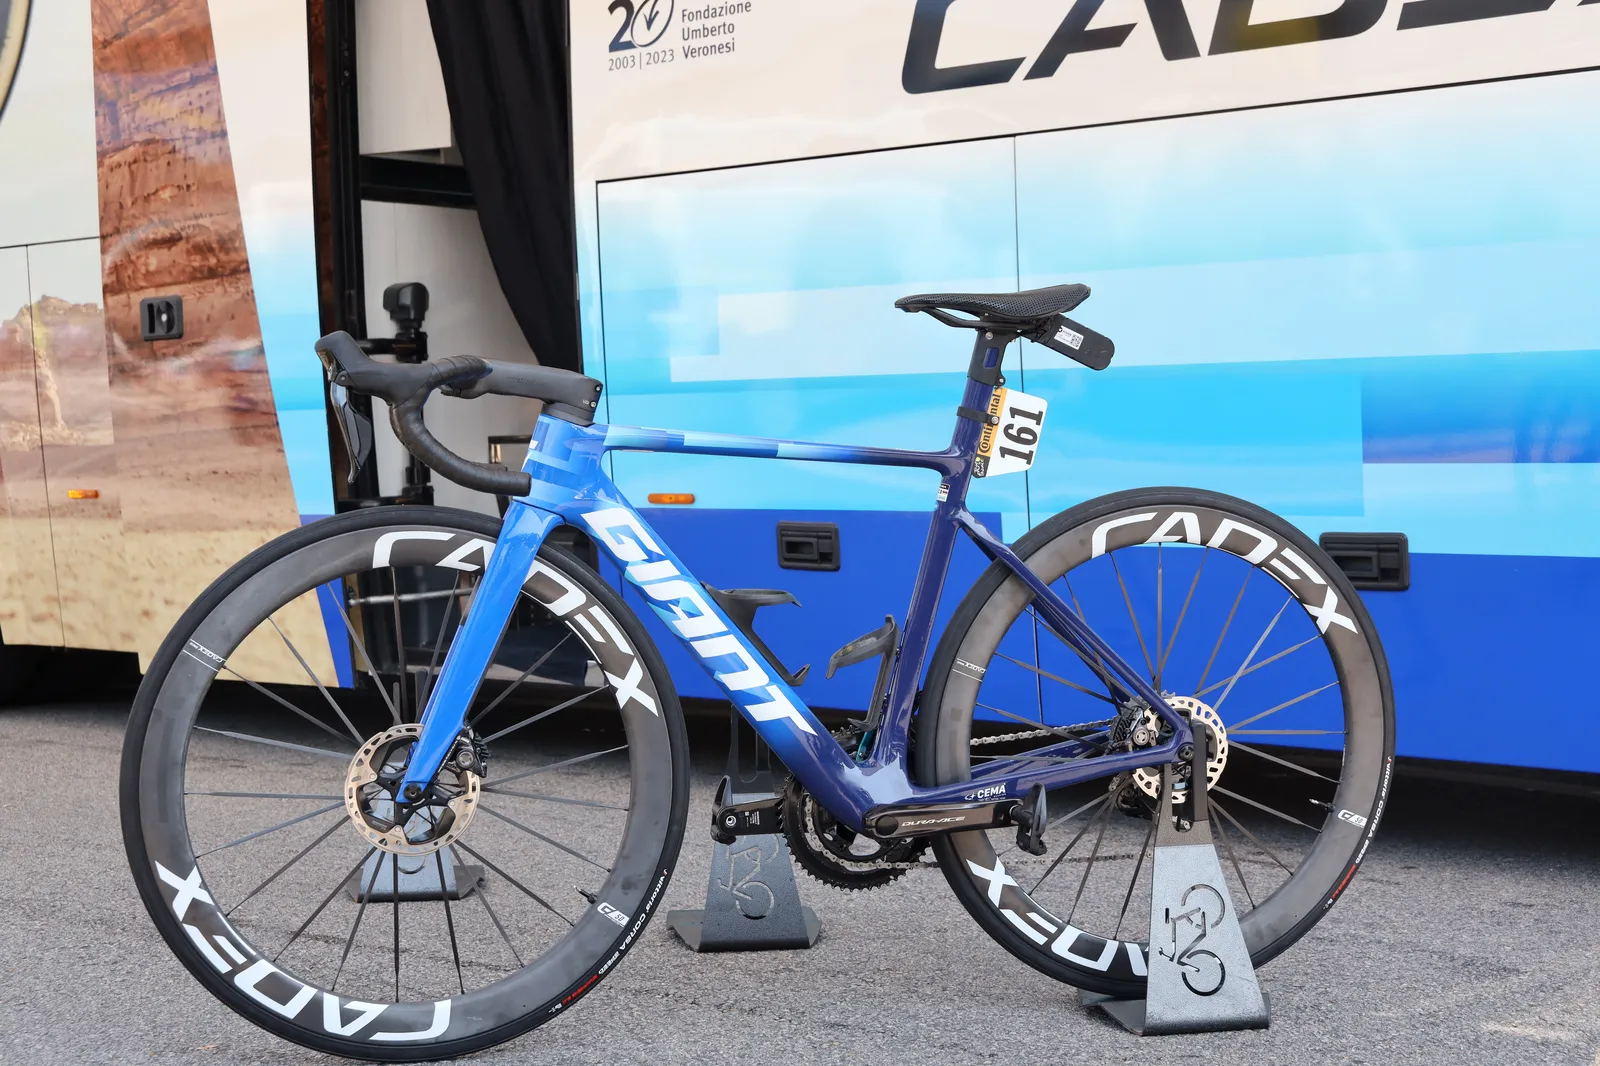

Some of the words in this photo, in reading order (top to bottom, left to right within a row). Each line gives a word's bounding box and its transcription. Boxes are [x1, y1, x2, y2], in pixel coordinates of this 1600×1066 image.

[681, 0, 751, 23] Fondazione
[682, 22, 735, 41] Umberto
[682, 38, 735, 60] Veronesi
[608, 55, 636, 71] 2003
[646, 49, 675, 66] 2023
[999, 406, 1044, 466] 161
[1091, 510, 1359, 635] CADEX
[580, 507, 819, 737] GIANT
[977, 783, 1006, 798] CEMA
[1368, 800, 1384, 838] CORSA
[154, 859, 452, 1042] CADEX
[619, 913, 647, 951] CORSA
